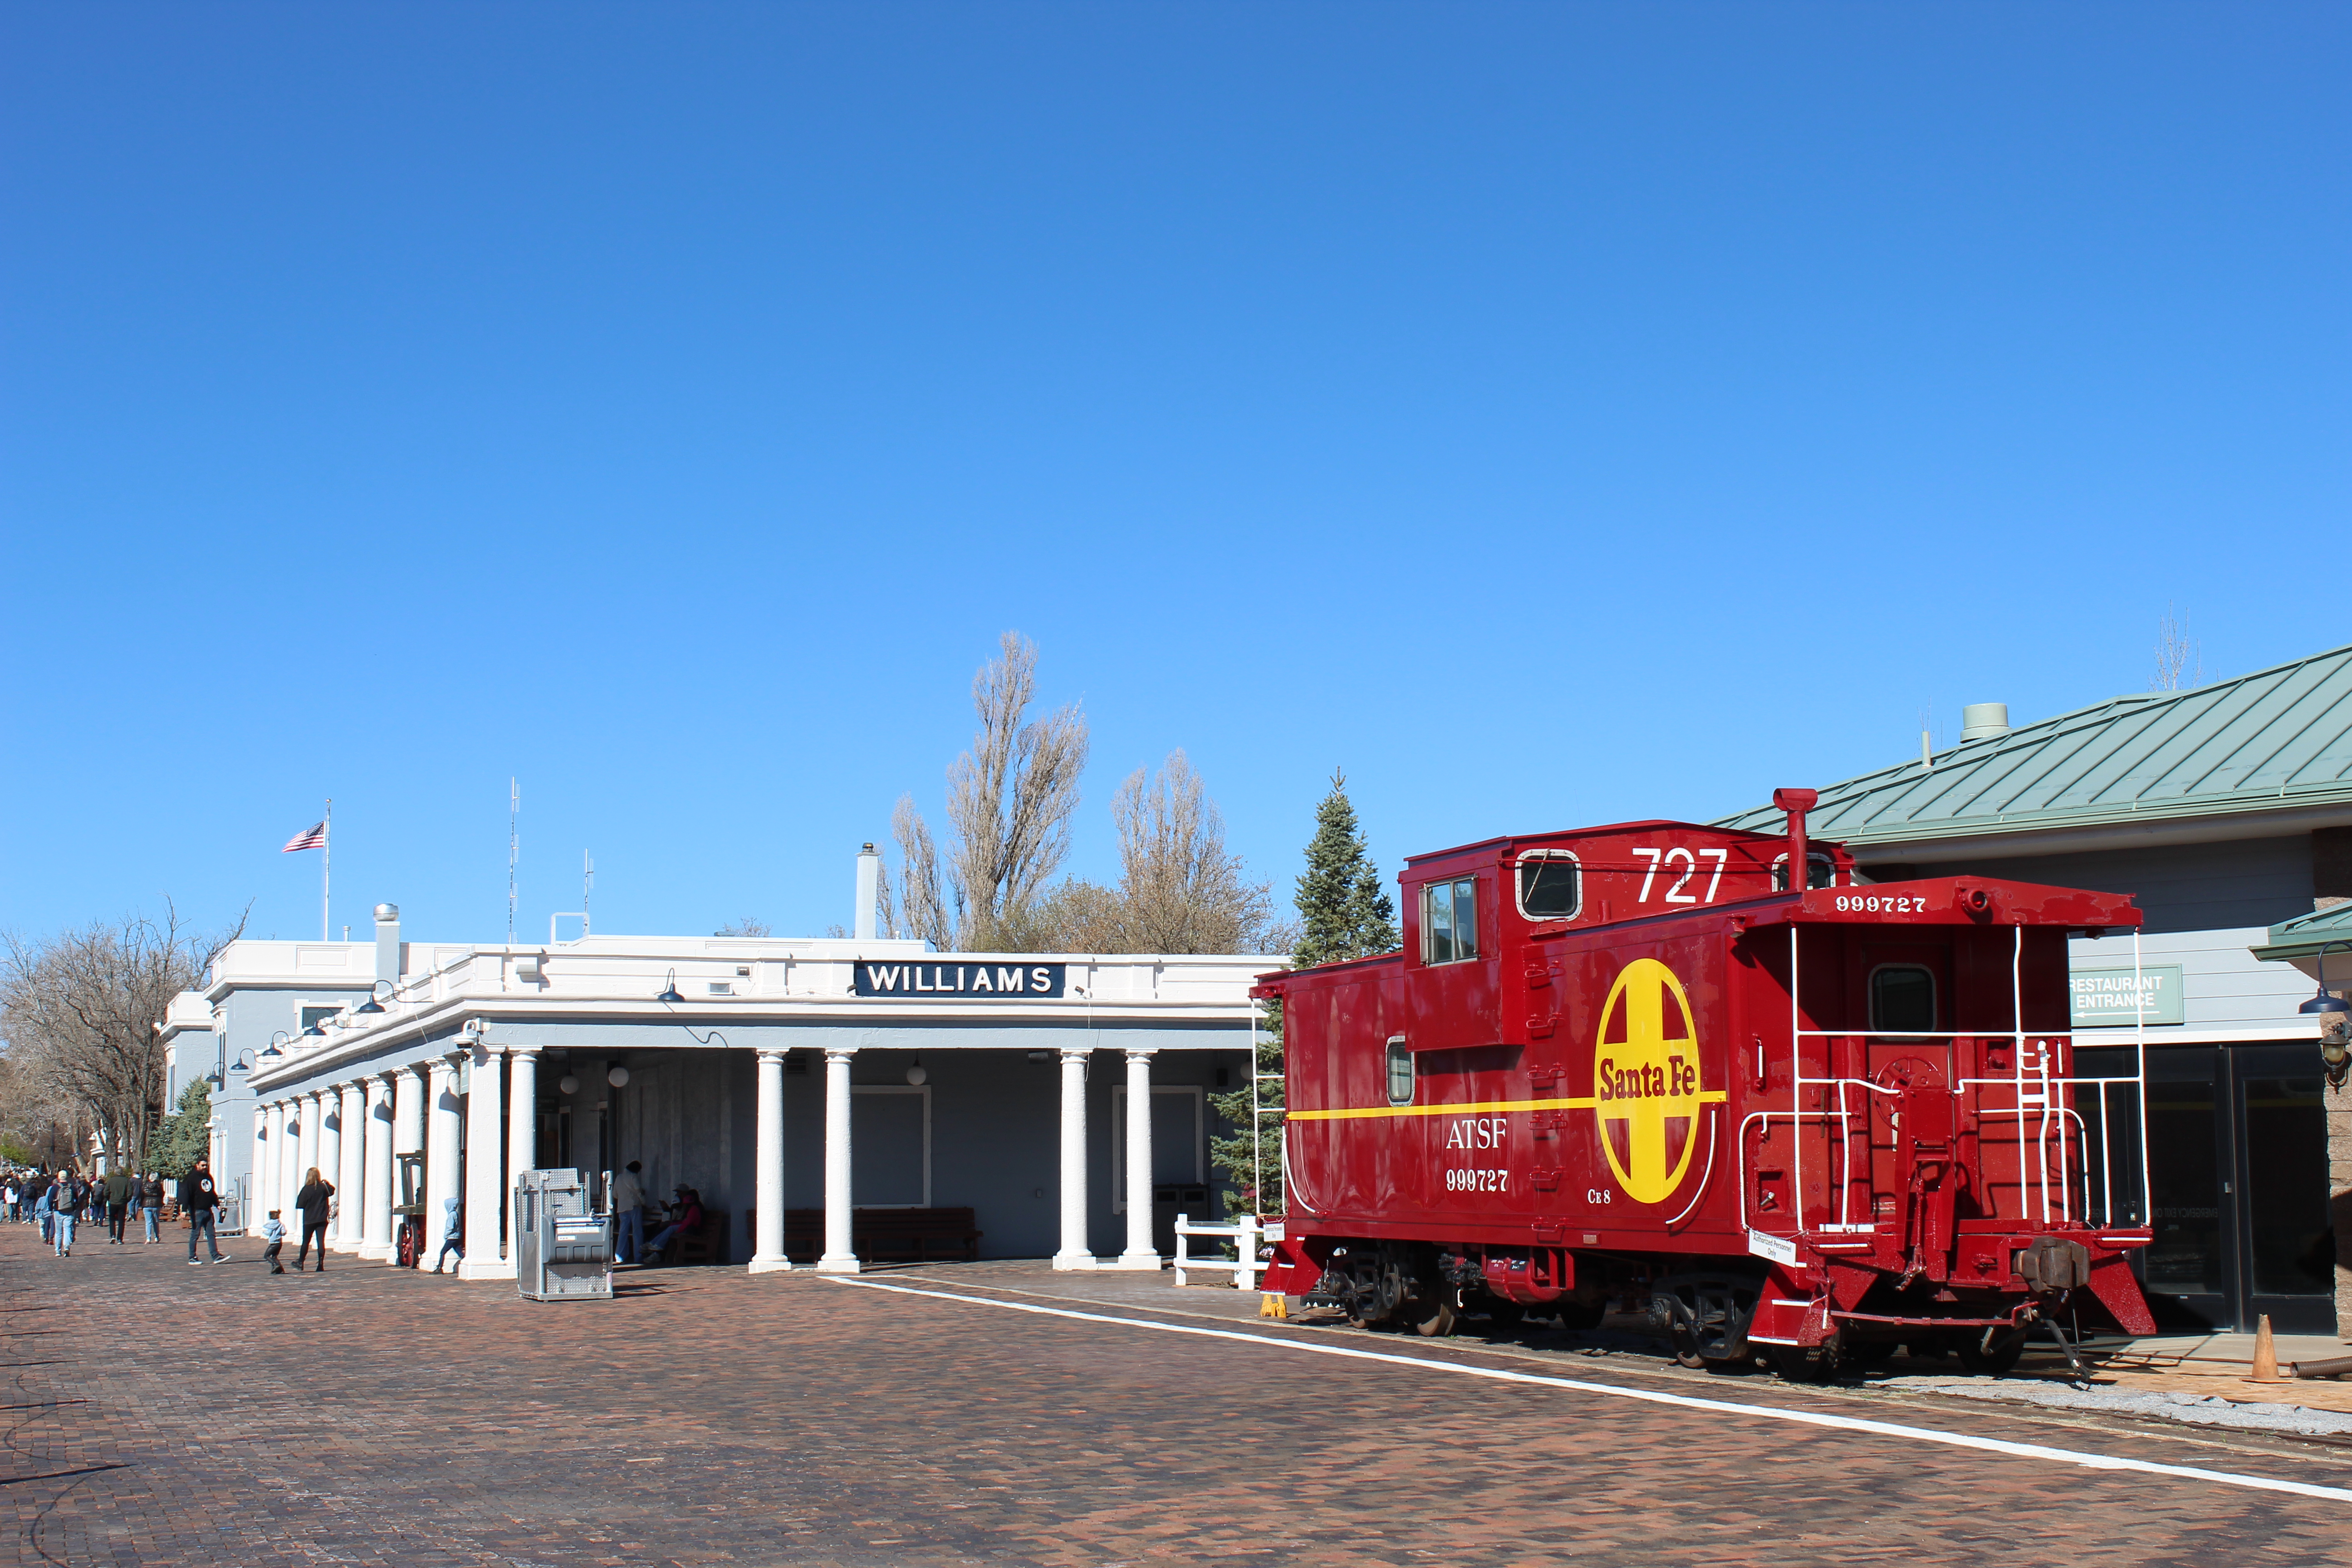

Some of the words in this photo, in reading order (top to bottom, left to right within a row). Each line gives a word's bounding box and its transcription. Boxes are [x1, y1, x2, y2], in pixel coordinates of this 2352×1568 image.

[1632, 847, 1727, 903] 727
[1836, 896, 1926, 912] 999727
[867, 965, 1052, 992] WILLIAMS
[2069, 976, 2163, 992] RESTAURANT
[2076, 992, 2155, 1009] ENTRANCE
[1600, 1058, 1666, 1101] Santa
[1668, 1055, 1695, 1096] Fe
[1446, 1119, 1507, 1149] ATSF
[1446, 1169, 1508, 1192] 999727
[1603, 1189, 1611, 1204] 8
[1753, 1233, 1773, 1246] Authorized
[1774, 1240, 1792, 1252] Personnel
[1768, 1248, 1776, 1258] Only
